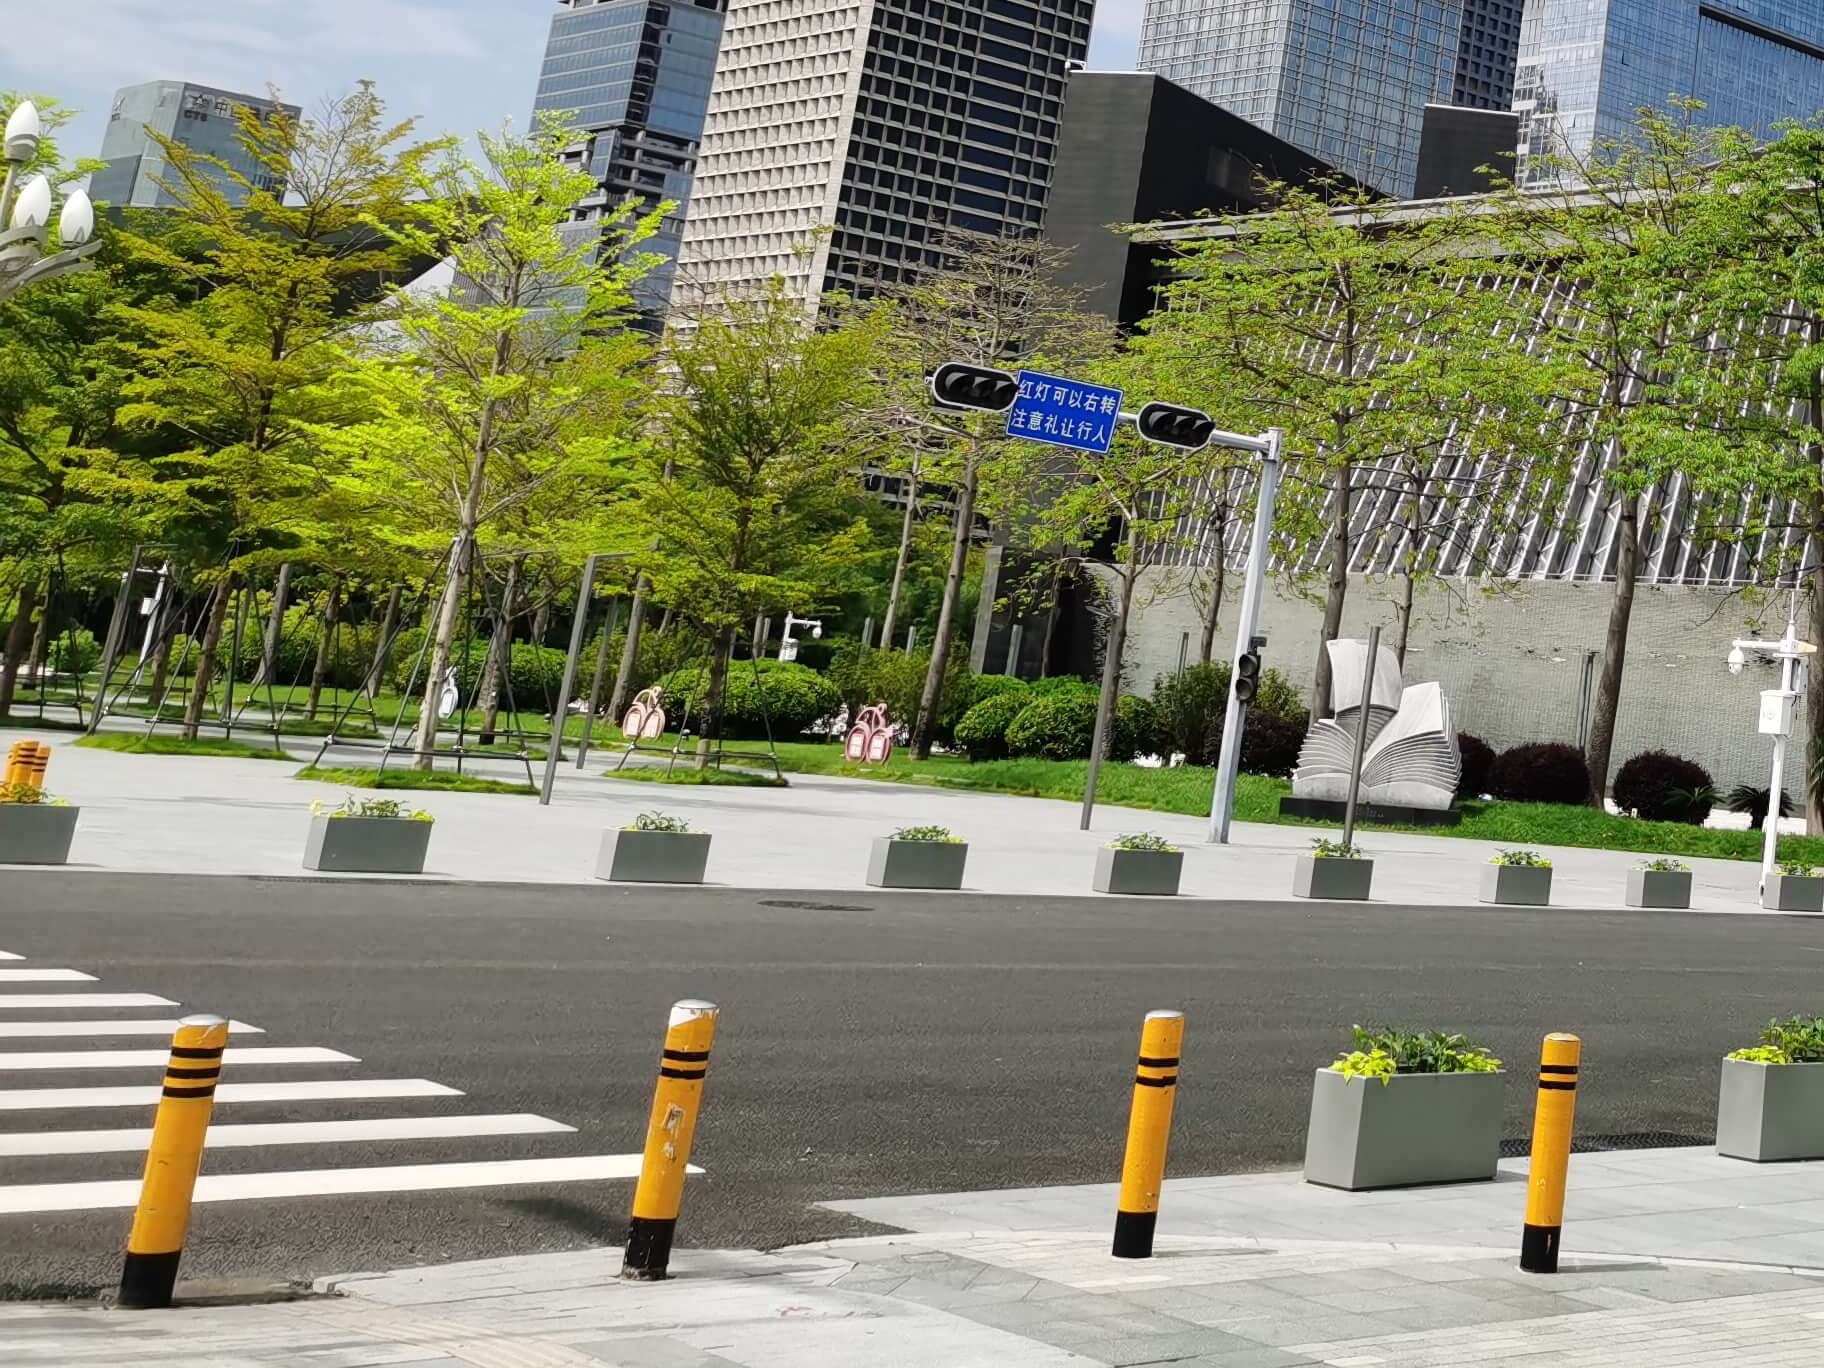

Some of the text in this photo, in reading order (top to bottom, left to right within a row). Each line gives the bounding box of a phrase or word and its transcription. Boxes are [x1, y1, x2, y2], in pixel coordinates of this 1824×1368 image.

[1017, 379, 1117, 415] 红灯可以右转
[1010, 408, 1106, 444] 注意礼让行人
